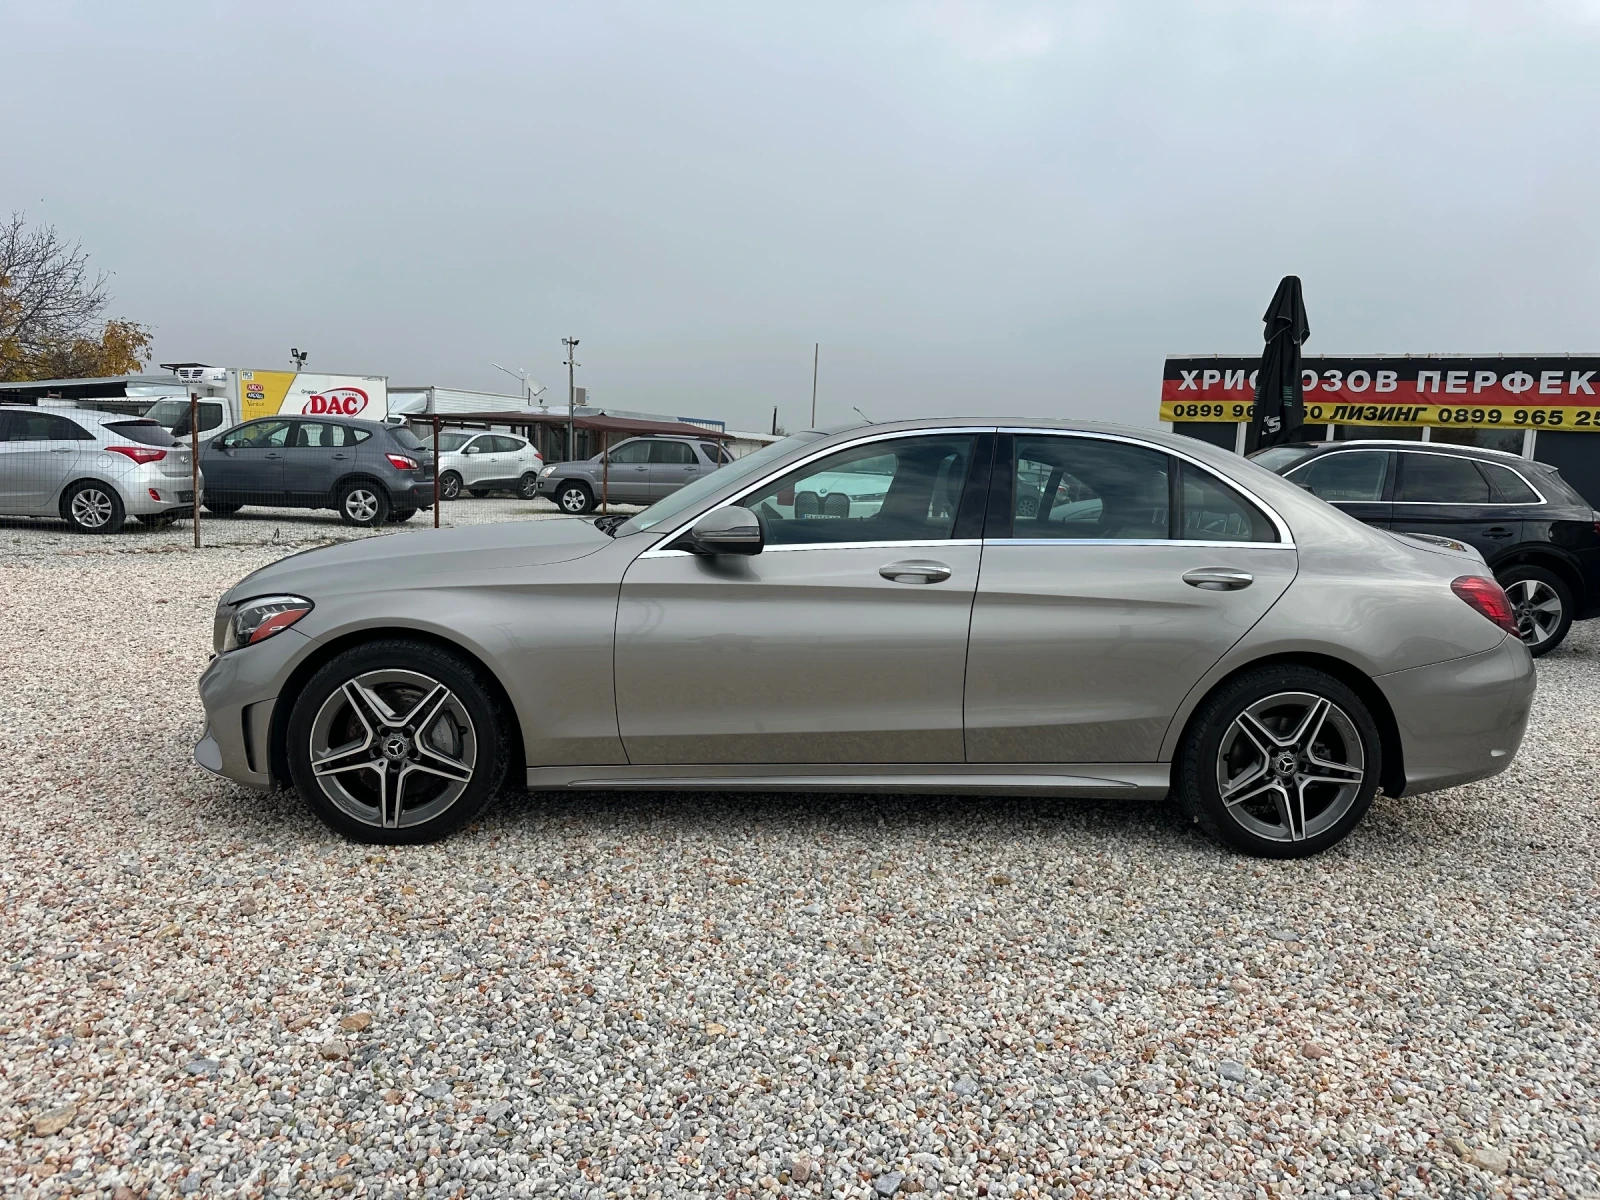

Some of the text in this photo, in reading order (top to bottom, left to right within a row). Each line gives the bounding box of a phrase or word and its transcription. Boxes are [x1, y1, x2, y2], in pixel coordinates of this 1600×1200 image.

[1177, 369, 1398, 392] ХРИОЗОВ
[309, 395, 358, 415] DAC
[1173, 404, 1224, 417] 0899
[1232, 404, 1255, 418] 96
[1329, 405, 1427, 422] ЛИЗИНГ
[1438, 408, 1502, 423] 0899
[1513, 409, 1564, 426] 965
